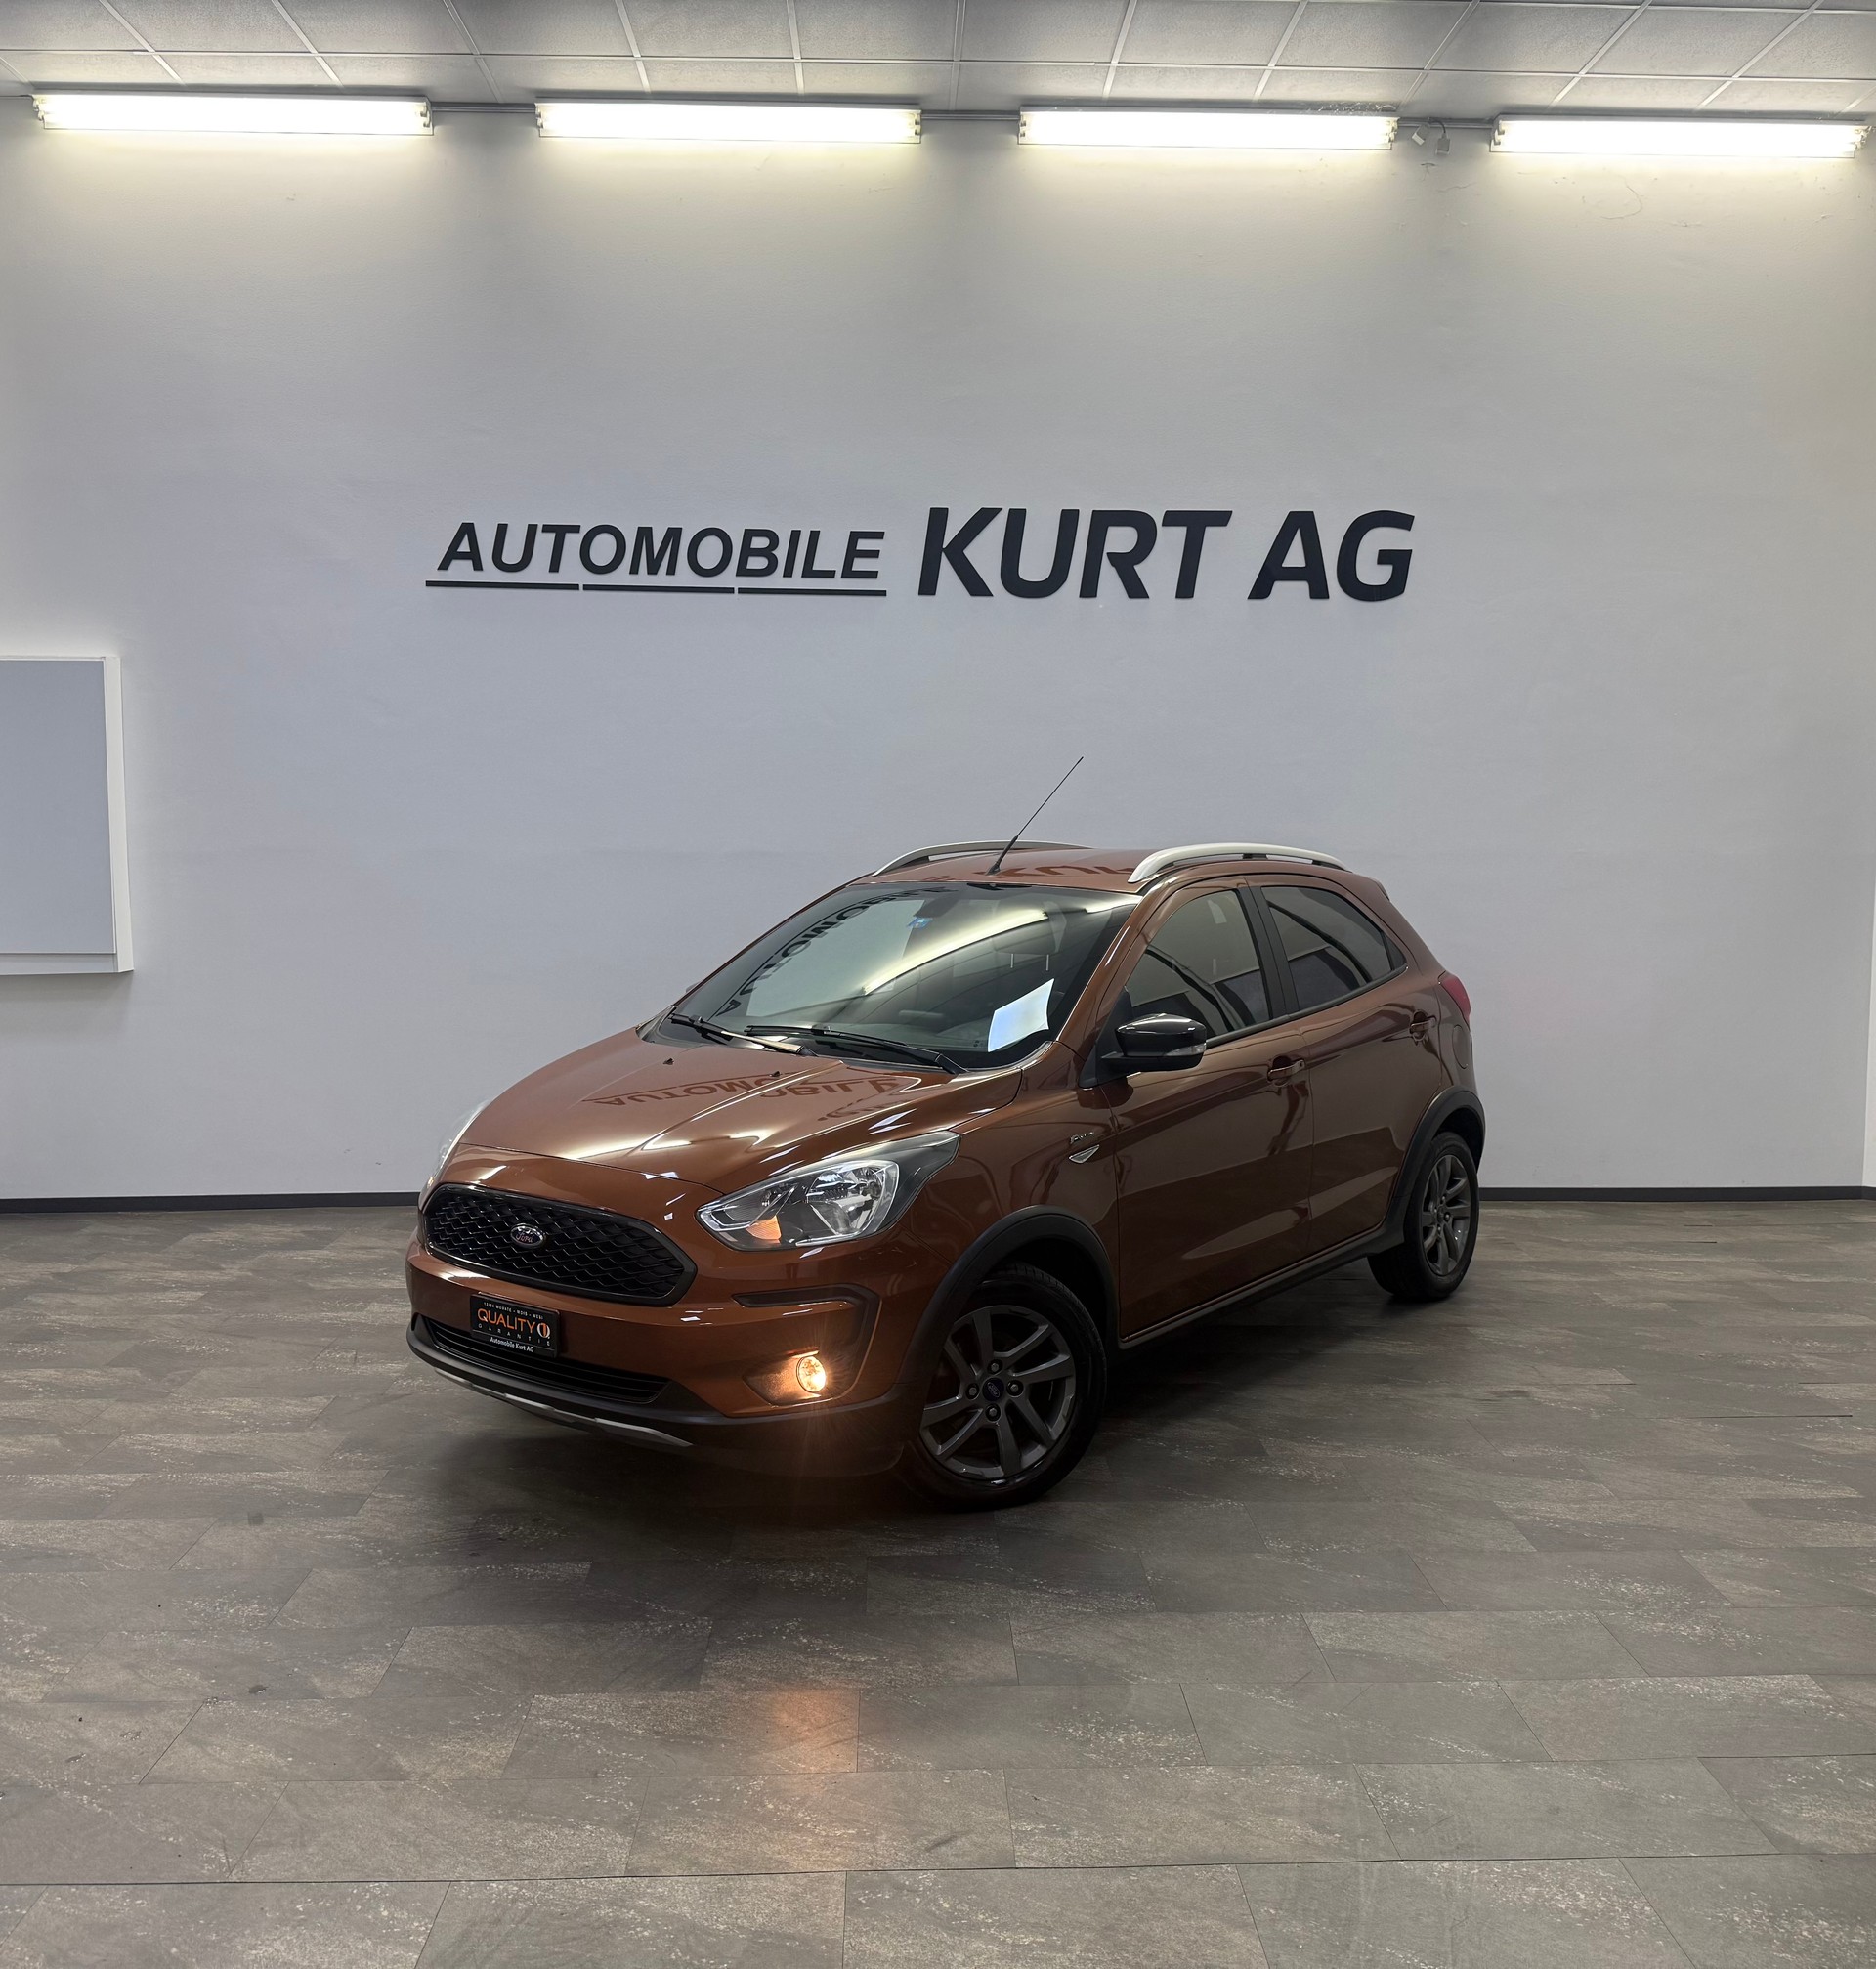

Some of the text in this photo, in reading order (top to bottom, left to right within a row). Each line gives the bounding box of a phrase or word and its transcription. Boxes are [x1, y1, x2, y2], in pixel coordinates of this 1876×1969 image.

[436, 506, 1416, 603] AUTOMOBILE KURT AG
[477, 1308, 536, 1334] QUALITY
[478, 1323, 550, 1347] GARANTIE
[490, 1336, 515, 1348] Automobile
[515, 1343, 526, 1351] Kurt
